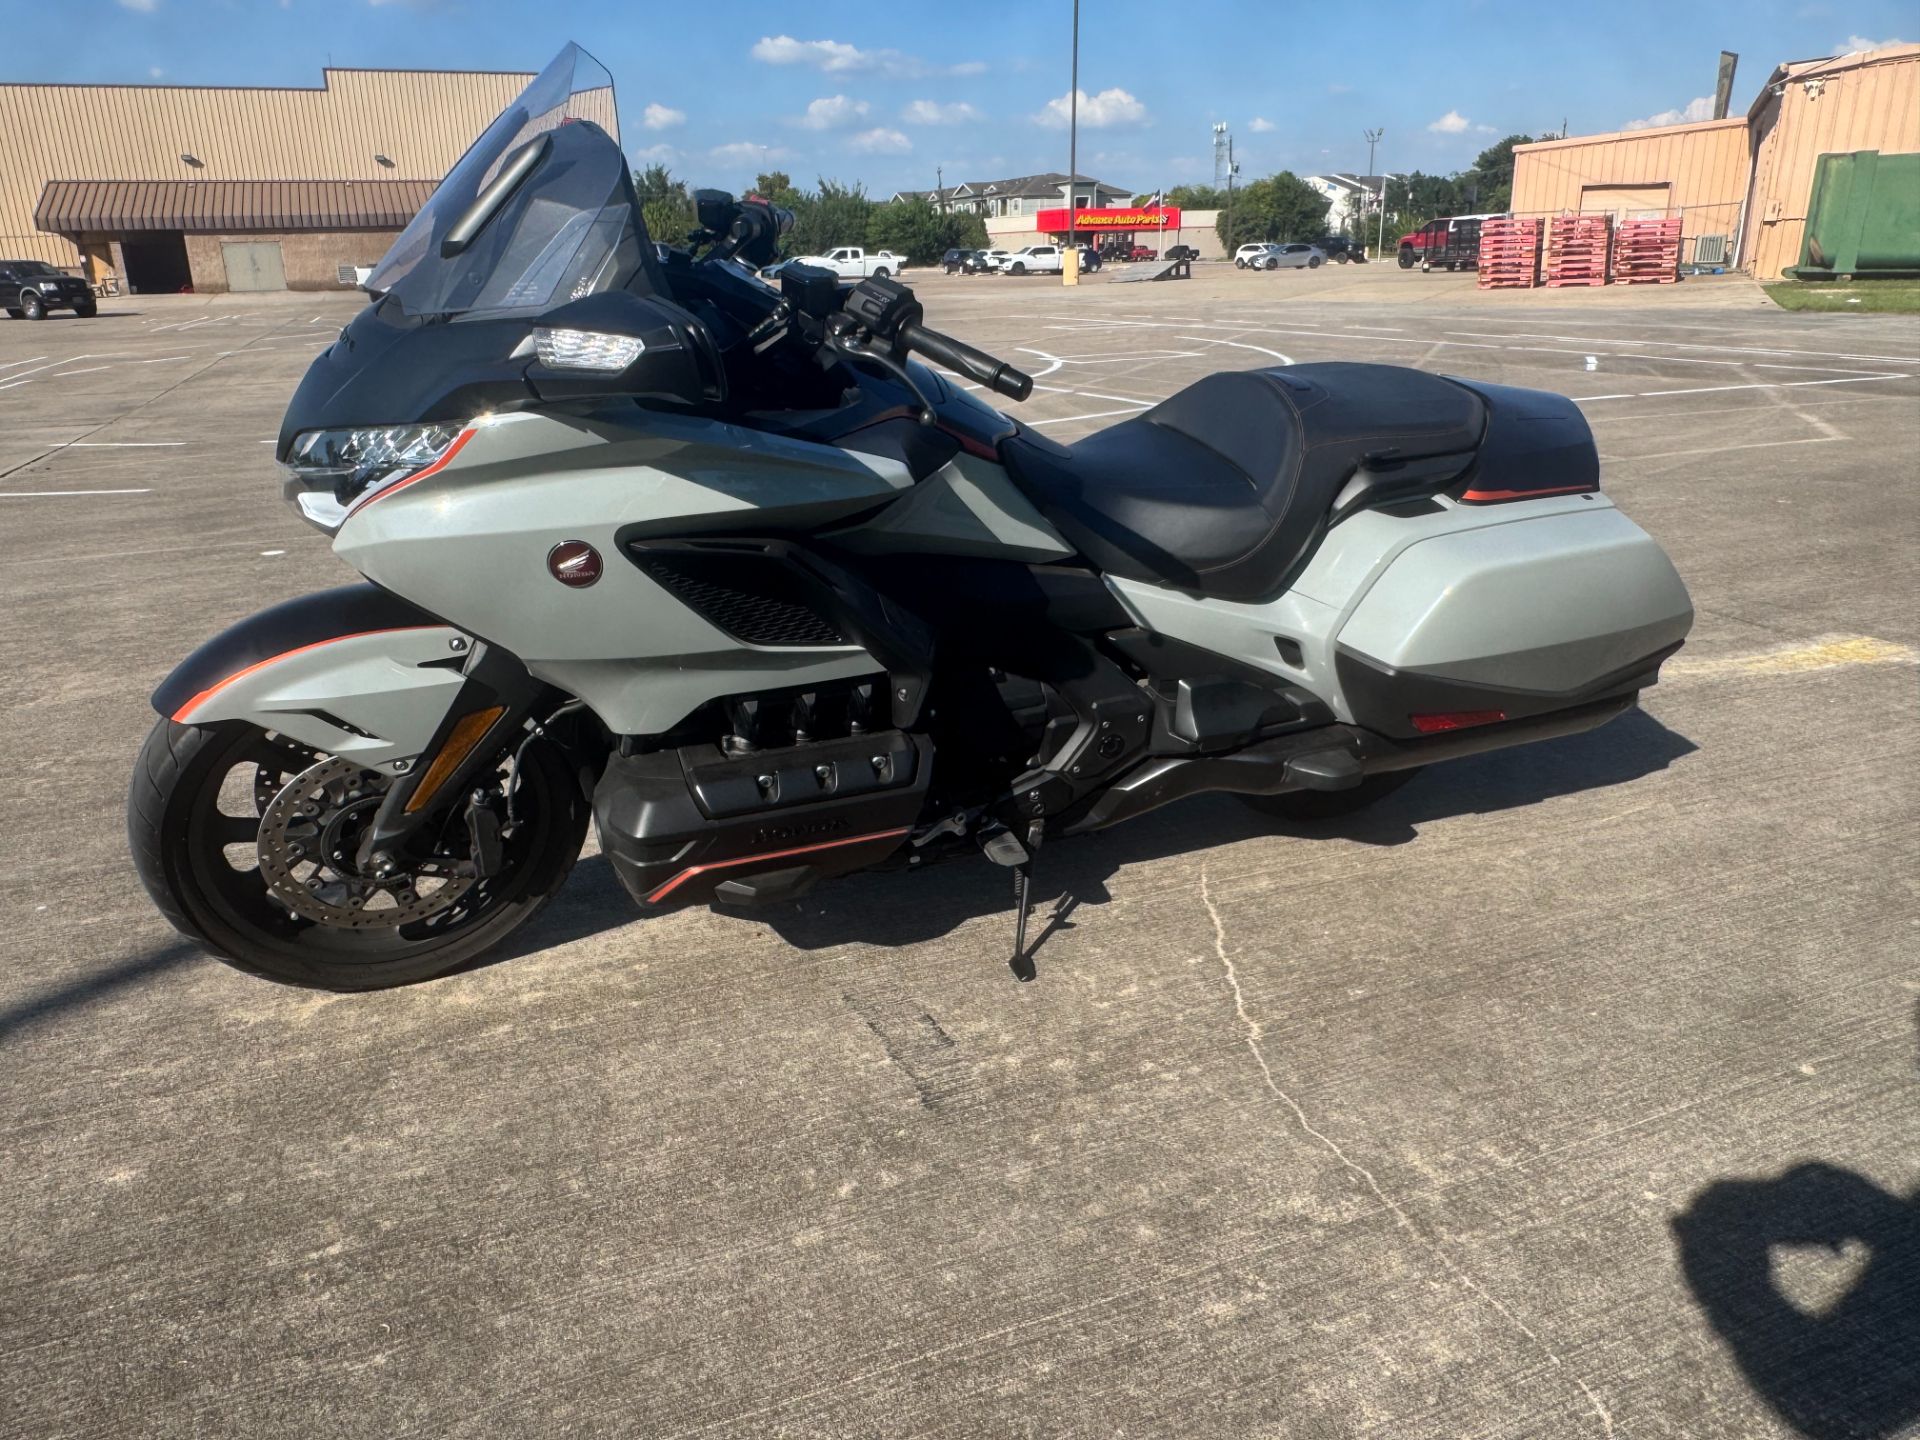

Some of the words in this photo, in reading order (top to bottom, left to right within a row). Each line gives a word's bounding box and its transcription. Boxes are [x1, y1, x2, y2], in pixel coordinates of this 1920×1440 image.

[1076, 214, 1113, 225] Advance
[1113, 215, 1135, 225] Auto
[1136, 214, 1159, 225] Parts
[559, 571, 595, 579] HONDA
